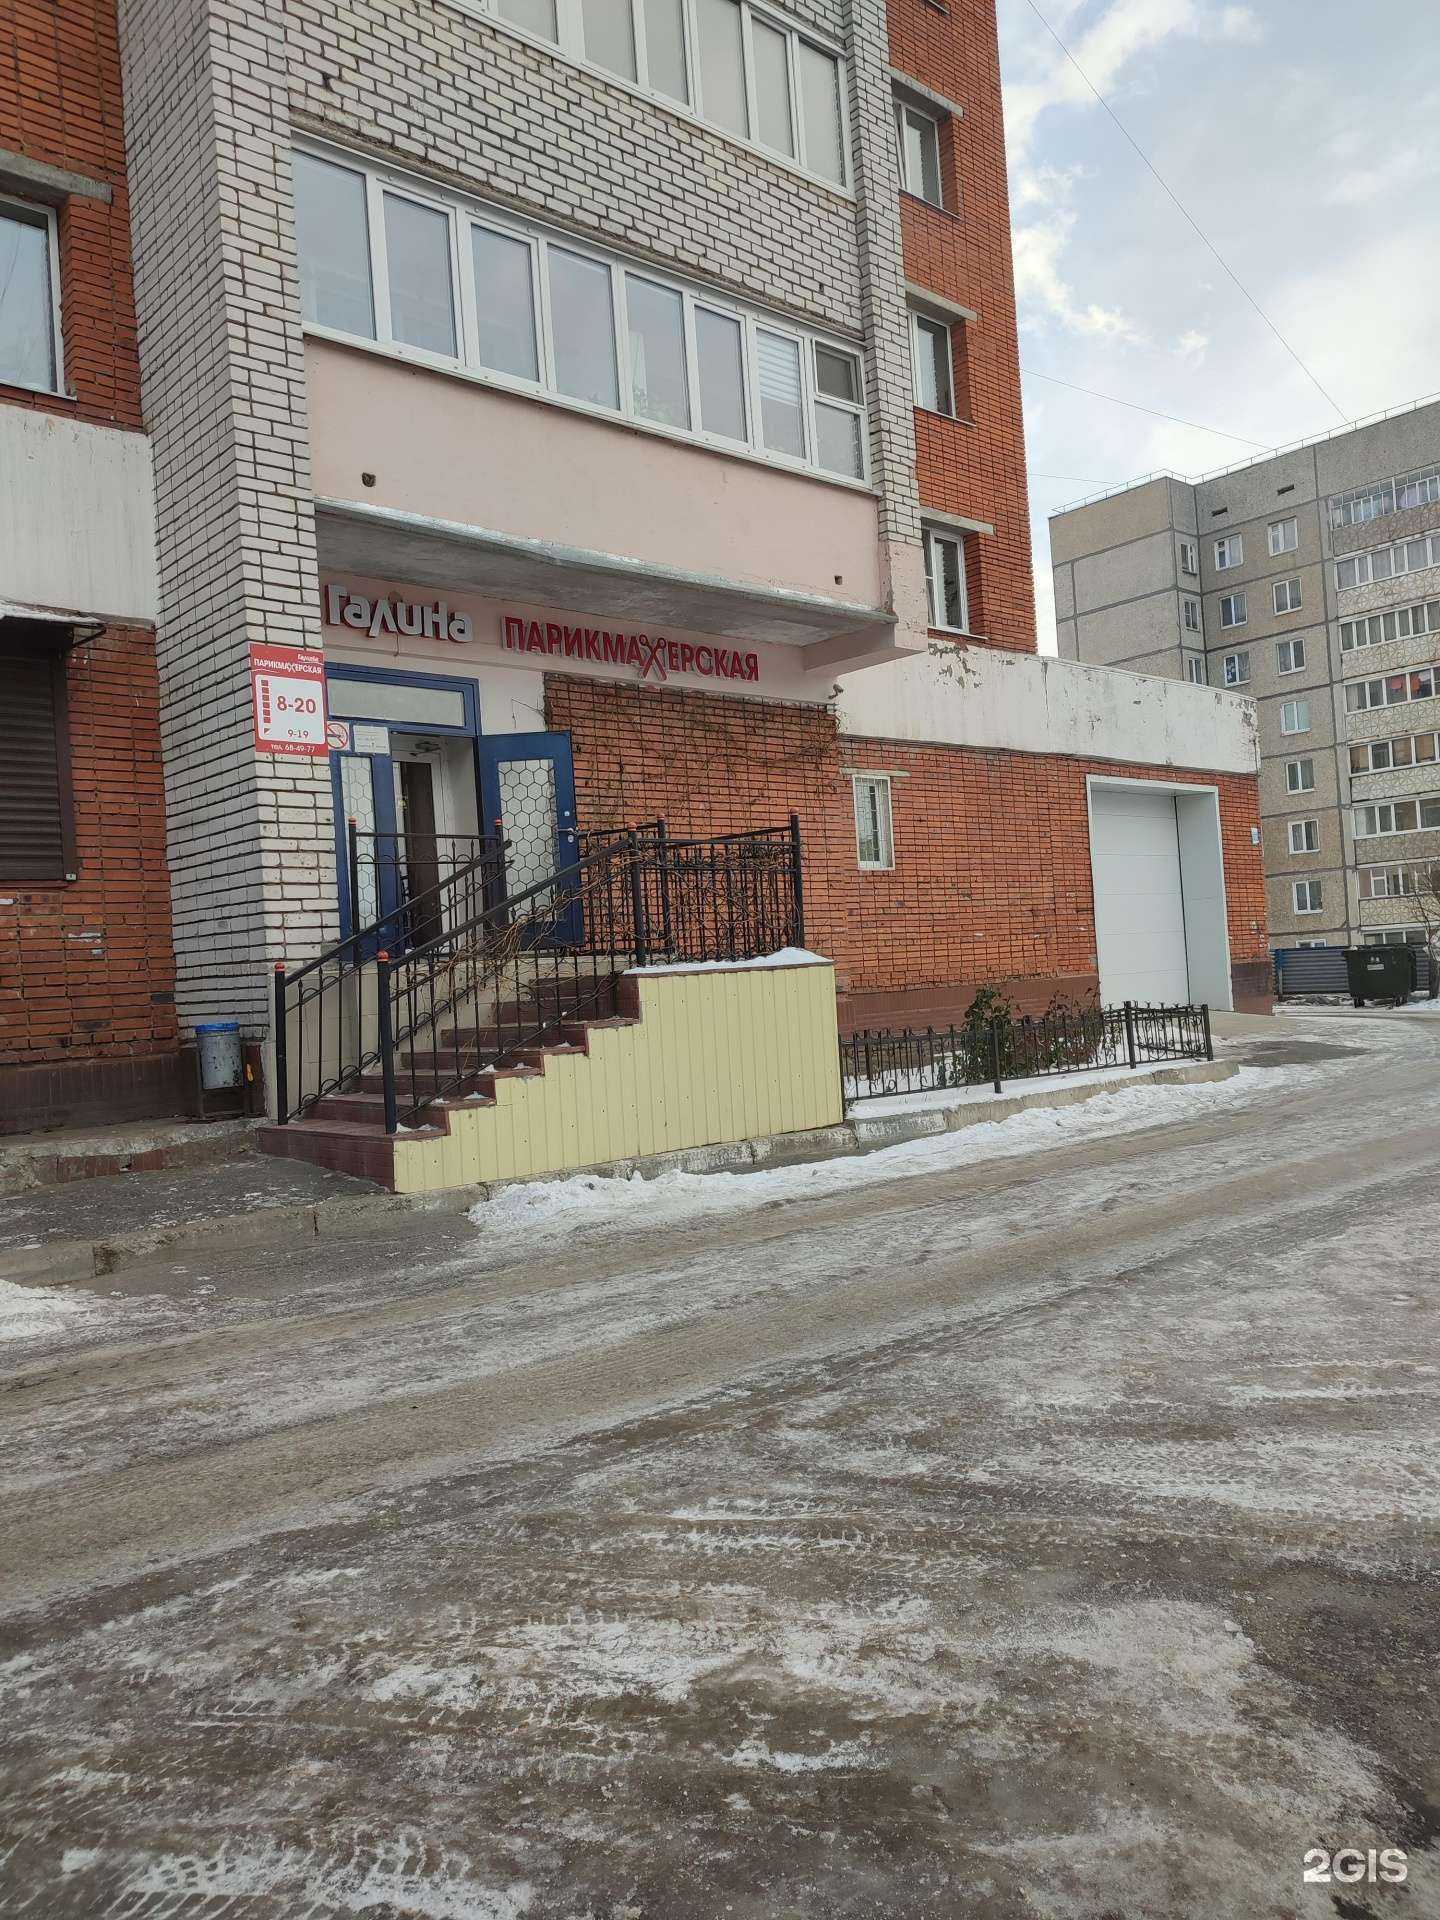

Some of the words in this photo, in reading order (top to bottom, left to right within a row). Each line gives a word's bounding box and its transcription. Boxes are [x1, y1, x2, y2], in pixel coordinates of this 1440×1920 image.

[325, 584, 473, 643] Галина
[276, 695, 316, 714] 8-20
[287, 729, 309, 739] 9-19
